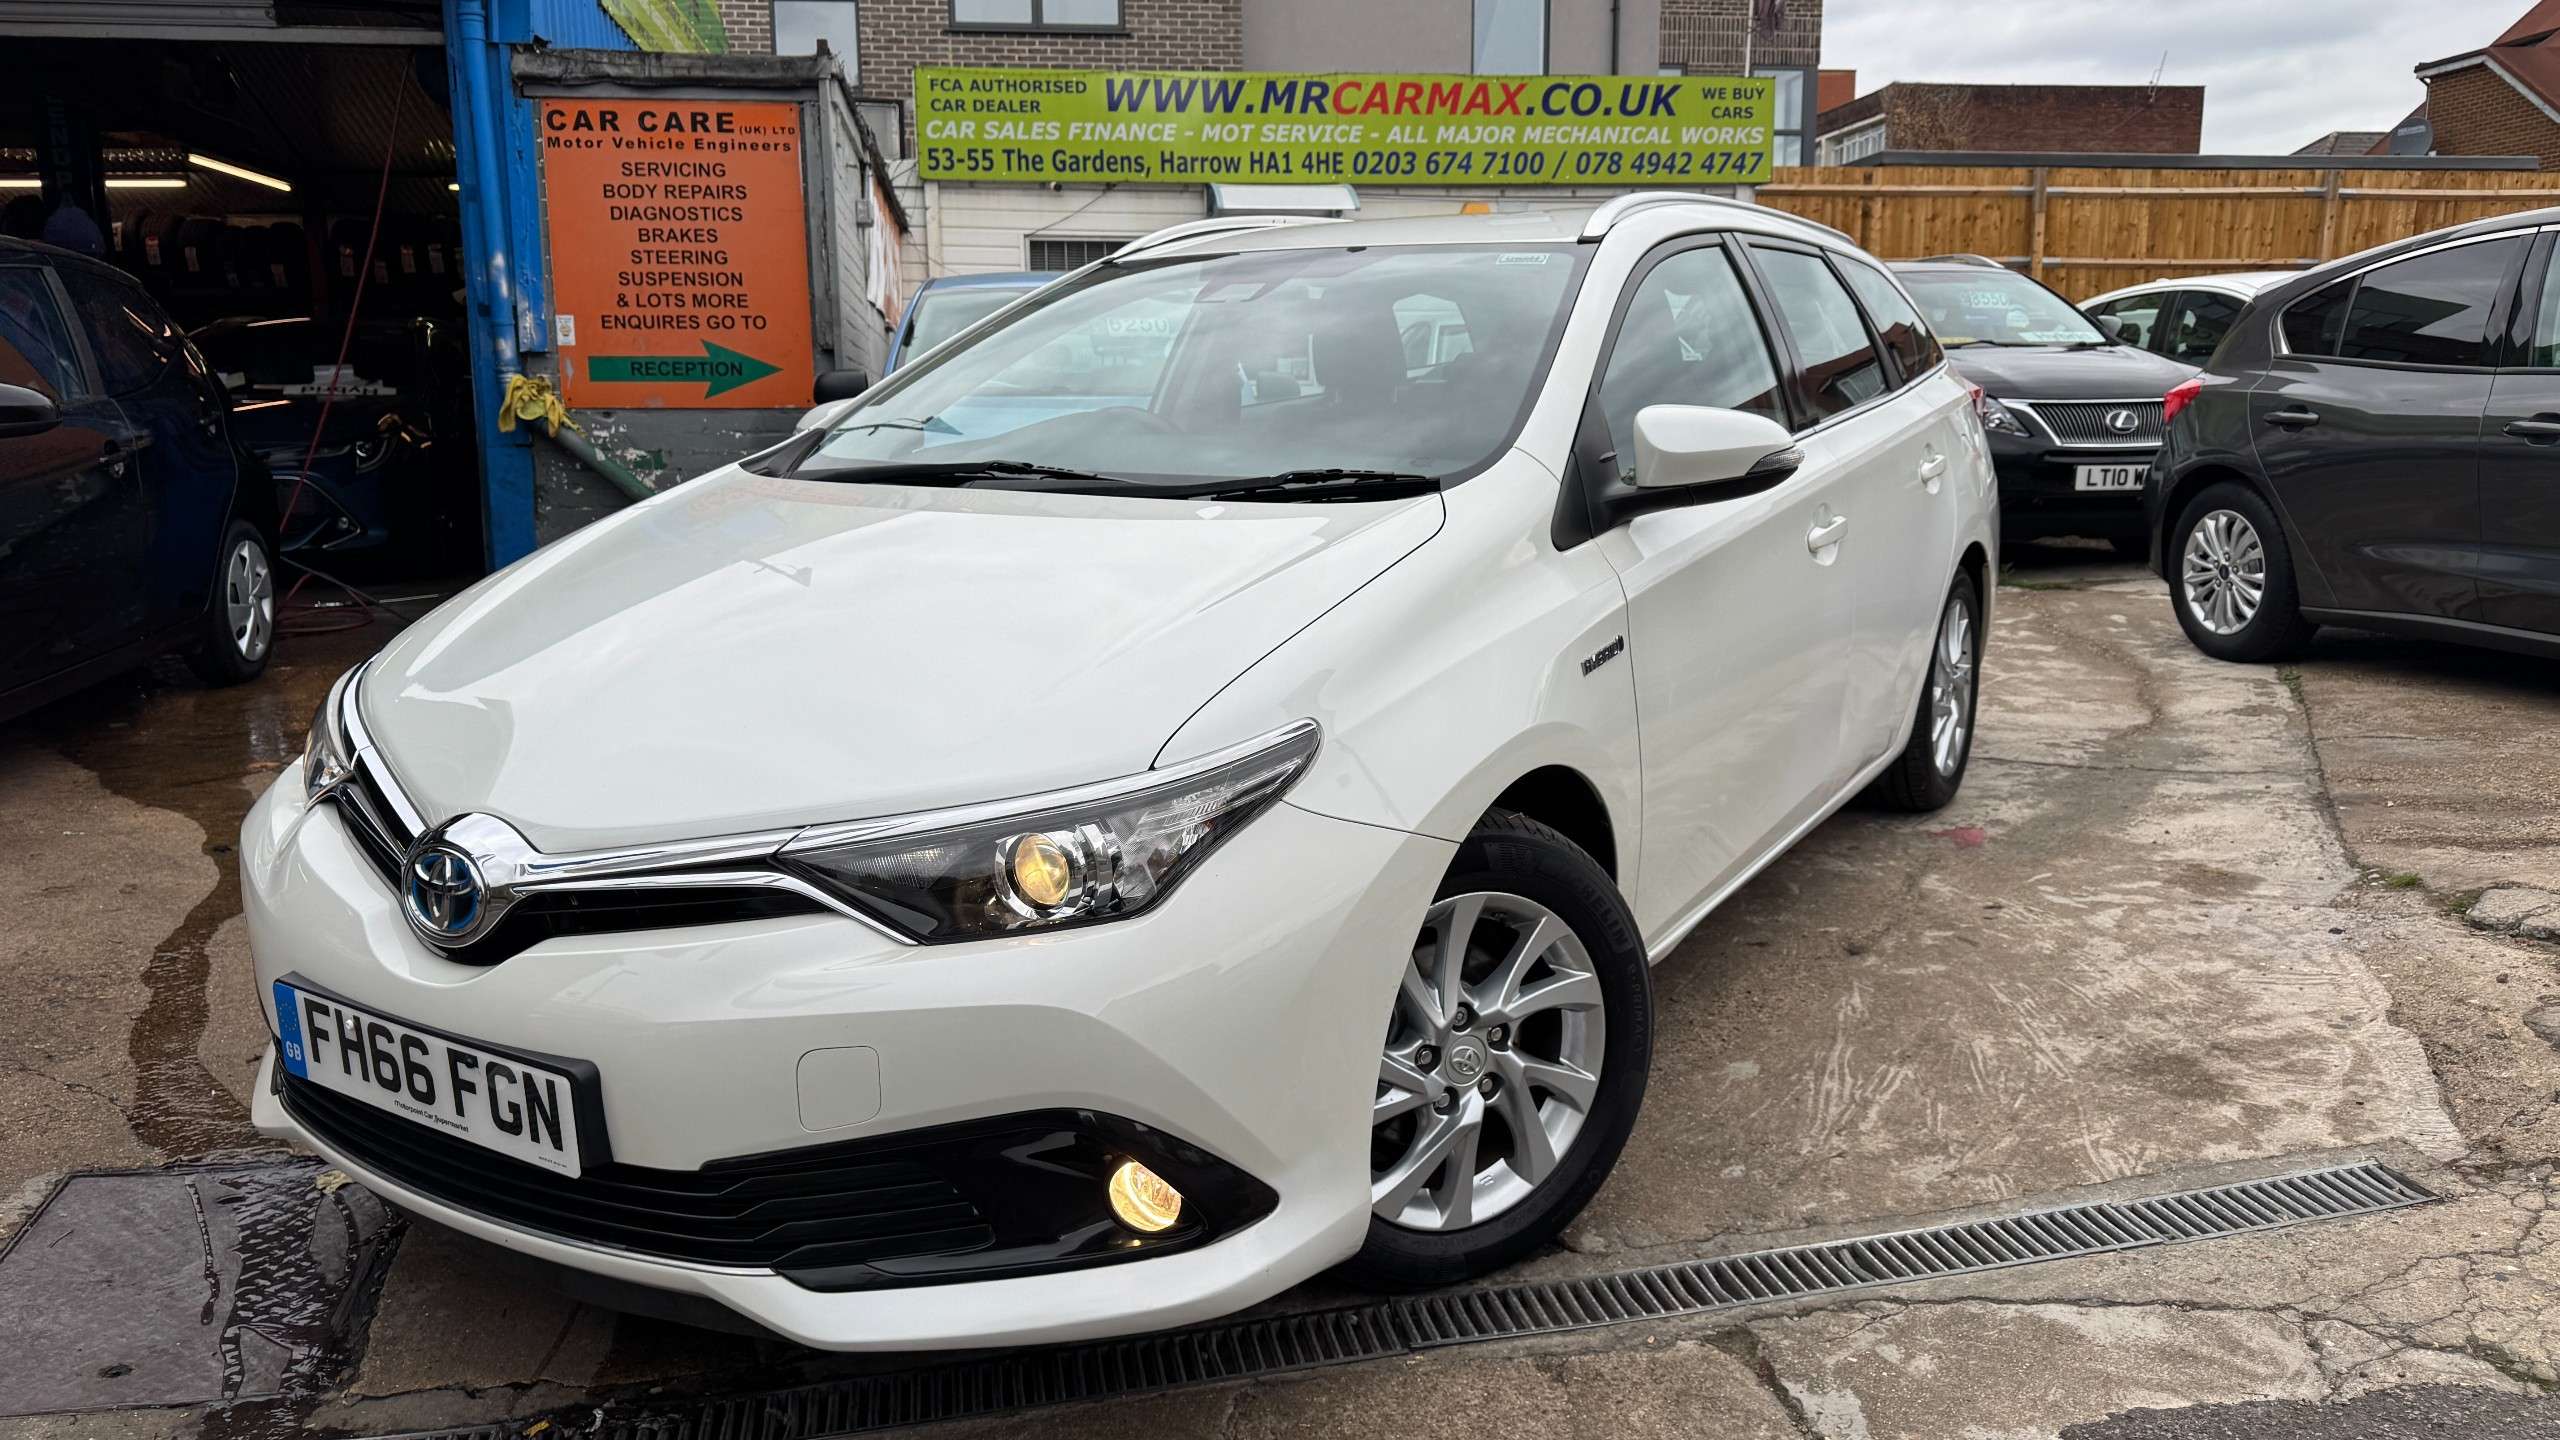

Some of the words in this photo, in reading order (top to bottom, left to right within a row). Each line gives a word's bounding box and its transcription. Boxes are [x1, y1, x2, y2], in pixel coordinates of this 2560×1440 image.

[929, 79, 963, 94] FCA
[969, 79, 1087, 95] AUTHORISED
[1702, 87, 1727, 100] WE
[1732, 87, 1766, 100] BUY
[1106, 78, 1682, 117] WWW.MRCARMAX.CO.UK
[930, 99, 967, 113] CAR
[972, 99, 1041, 114] DEALER
[1711, 106, 1754, 120] CARS
[546, 108, 621, 132] CAR
[637, 110, 735, 134] CARE
[739, 125, 768, 136] (UK)
[772, 126, 796, 136] LTD
[926, 120, 976, 140] CAR
[983, 120, 1061, 141] SALES
[1068, 121, 1177, 143] FINANCE
[1201, 123, 1255, 143] MOT
[1261, 123, 1363, 144] SERVICE
[1385, 125, 1429, 144] ALL
[1435, 125, 1515, 145] MAJOR
[1523, 125, 1672, 145] MECHANICAL
[1680, 125, 1765, 145] WORKS
[547, 136, 603, 149] Motor
[612, 137, 686, 150] Vehicle
[694, 138, 792, 154] Engineers
[621, 162, 726, 178] SERVICING
[927, 148, 995, 172] 53-55
[1001, 148, 1044, 172] The
[1051, 149, 1151, 178] Gardens,
[1159, 150, 1241, 174] Harrow
[1249, 150, 1293, 174] HA1
[1301, 150, 1344, 175] 4HE
[1352, 151, 1417, 176] 0203
[1425, 151, 1472, 176] 674
[1482, 151, 1545, 176] 7100
[1552, 151, 1567, 179] /
[1575, 151, 1622, 176] 078
[1630, 151, 1692, 176] 4942
[1700, 151, 1764, 176] 4747
[603, 184, 658, 199] BODY
[664, 185, 747, 200] REPAIRS
[610, 206, 743, 222] DIAGNOSTICS
[638, 228, 718, 243] BRAKES
[631, 250, 728, 265] STEERING
[618, 271, 744, 287] SUSPENSION
[616, 293, 629, 308] &
[636, 293, 686, 308] LOTS
[692, 293, 749, 308] MORE
[601, 315, 701, 331] ENQUIRES
[706, 315, 735, 330] GO
[741, 315, 767, 330] TO
[630, 361, 743, 377] RECEPTION
[2086, 467, 2129, 487] LT10
[285, 1040, 303, 1062] GB
[303, 997, 437, 1106] FH66
[446, 1047, 564, 1152] FGN
